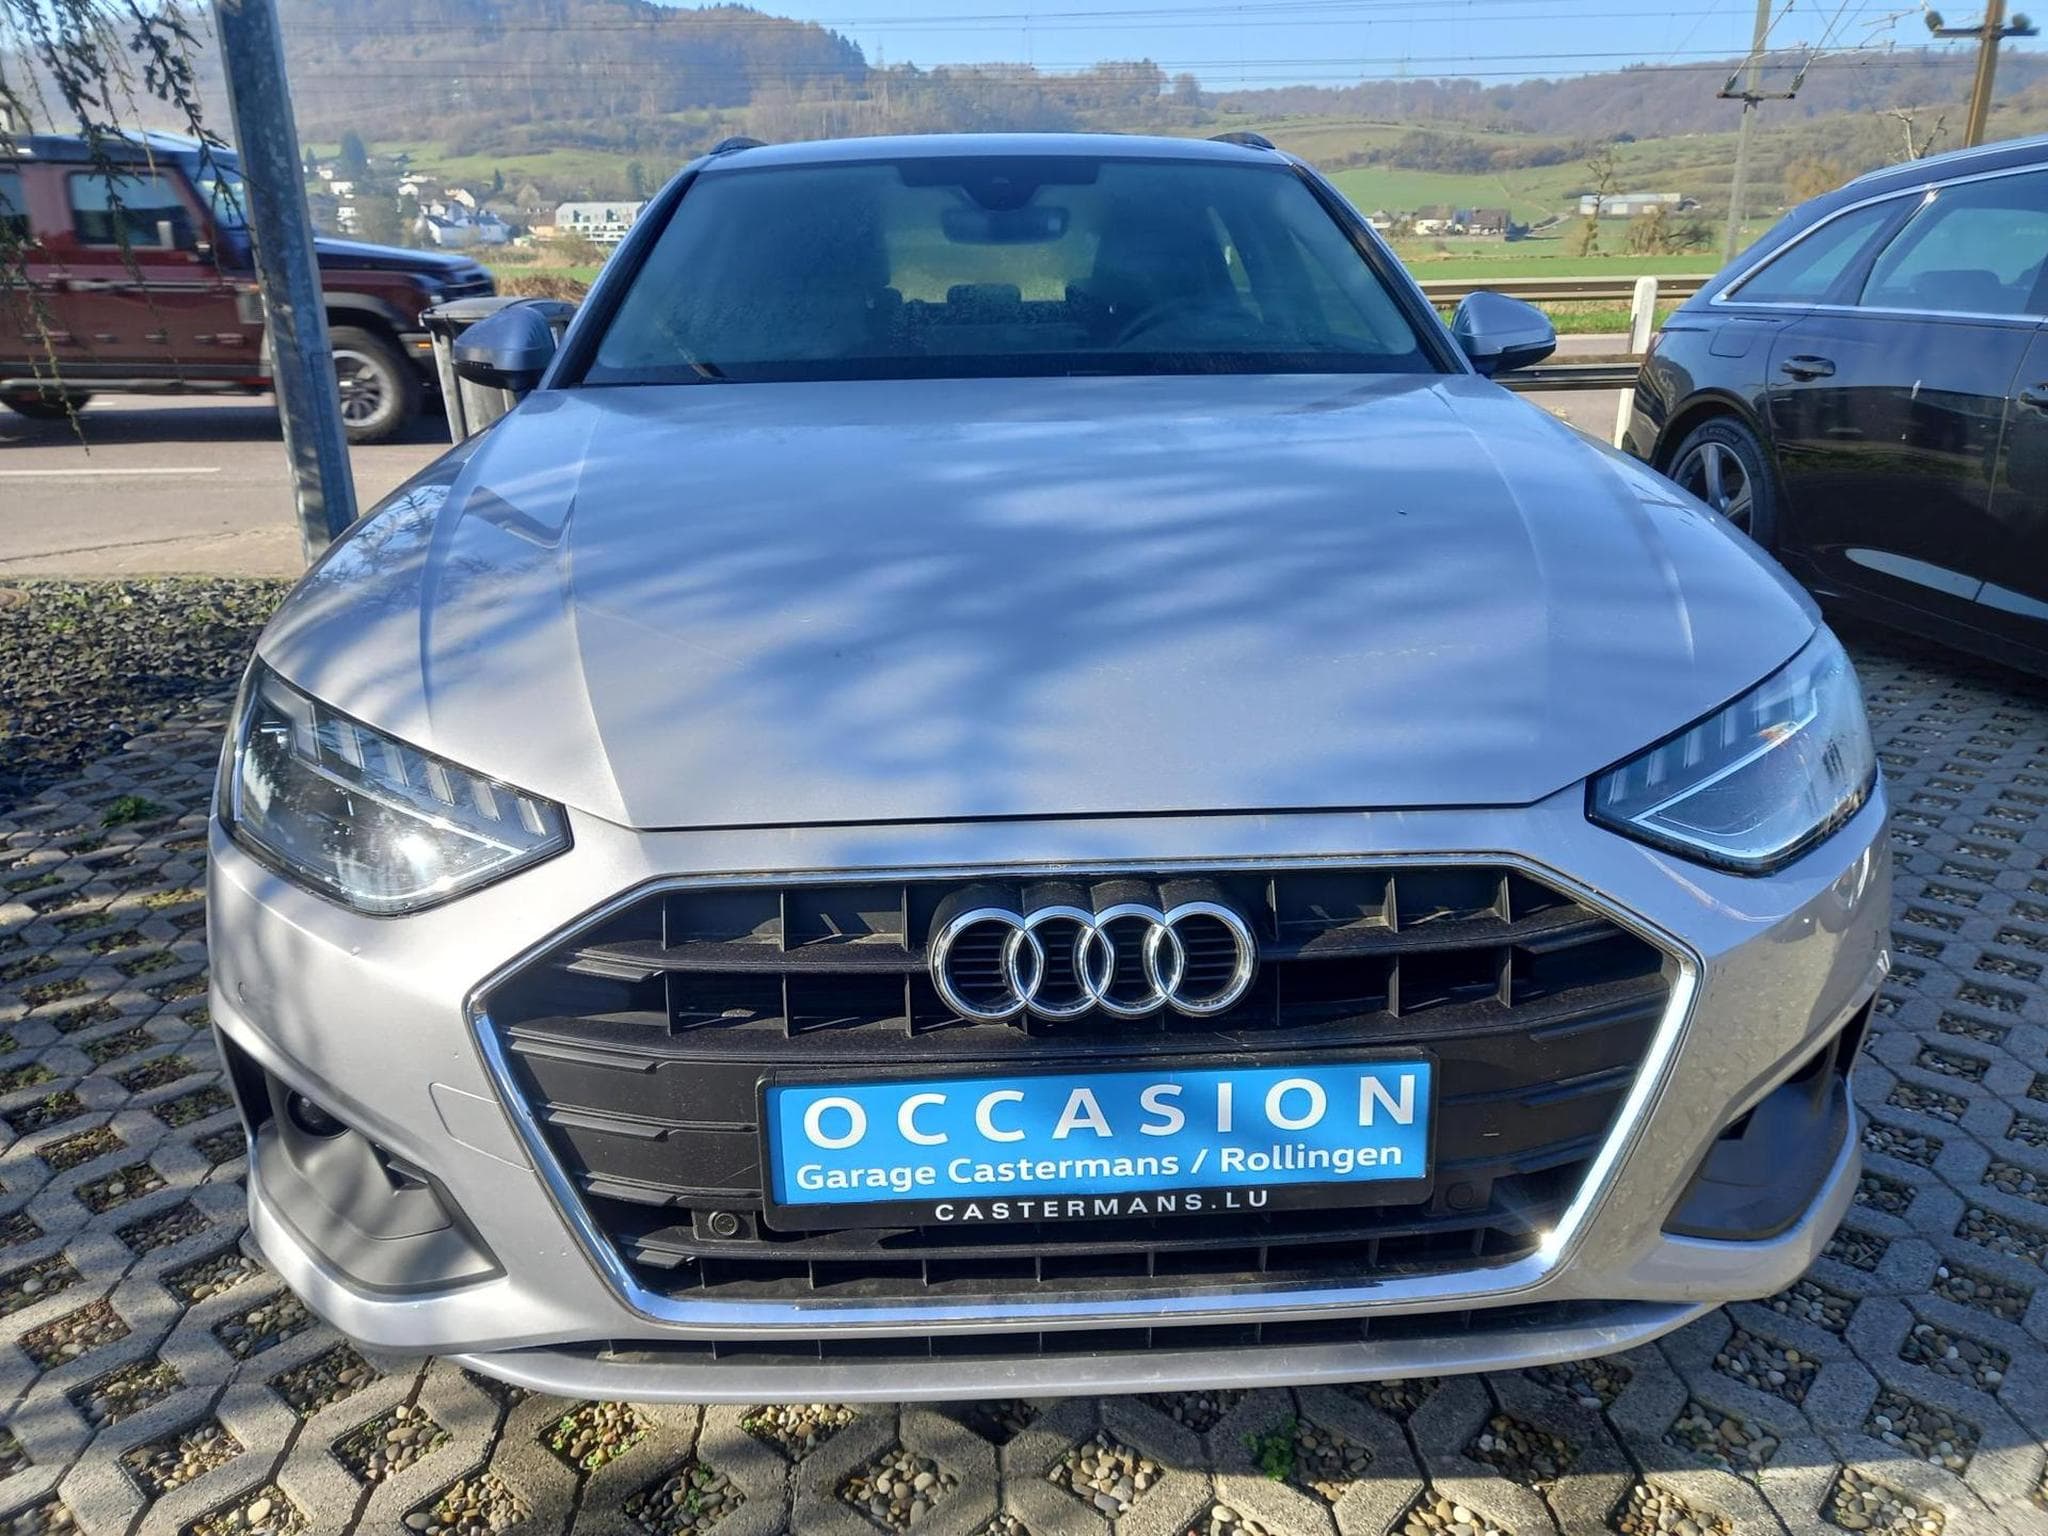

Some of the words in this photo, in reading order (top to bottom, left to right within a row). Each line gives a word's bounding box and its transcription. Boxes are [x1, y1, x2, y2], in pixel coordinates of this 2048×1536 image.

[803, 1075, 1415, 1149] OCCASION
[797, 1163, 936, 1193] Garage
[948, 1152, 1179, 1184] Castermans
[1220, 1143, 1402, 1174] Rollingen
[934, 1190, 1269, 1222] CASTERMANS.LU
